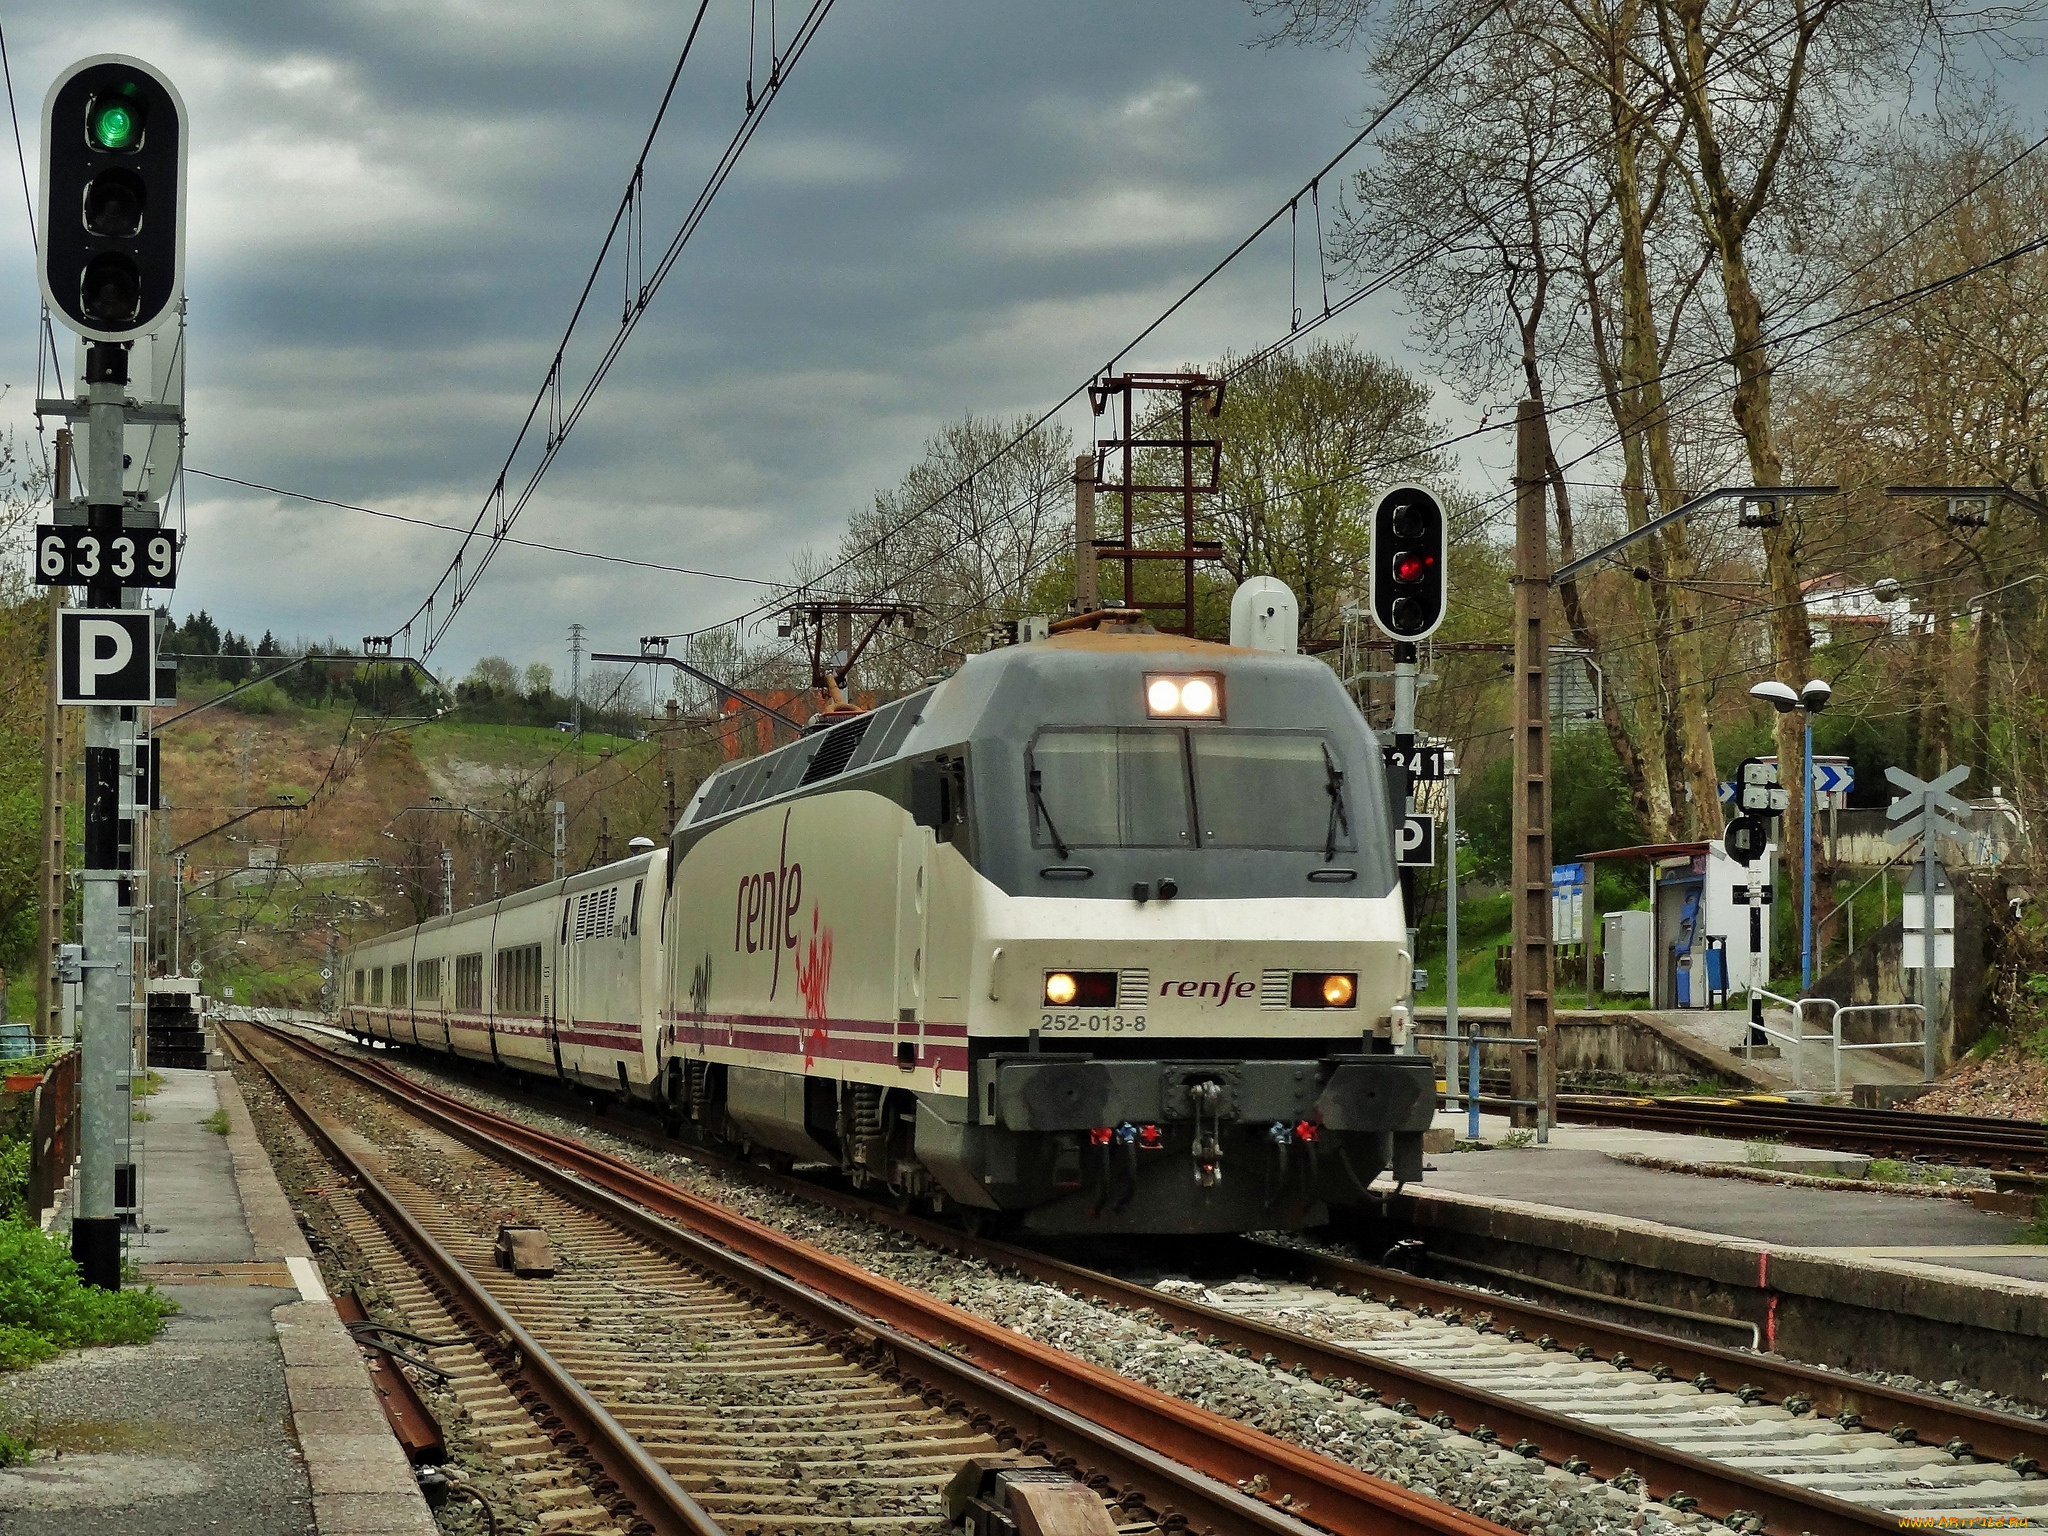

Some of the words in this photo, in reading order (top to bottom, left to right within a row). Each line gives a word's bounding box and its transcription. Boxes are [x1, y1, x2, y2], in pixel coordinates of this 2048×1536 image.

[40, 536, 172, 578] 6339
[79, 619, 134, 696] P
[1381, 752, 1439, 776] 341
[1395, 819, 1424, 861] P
[735, 806, 802, 1002] renfe
[1159, 971, 1256, 1007] renfe
[1041, 1014, 1146, 1032] 252-013-8
